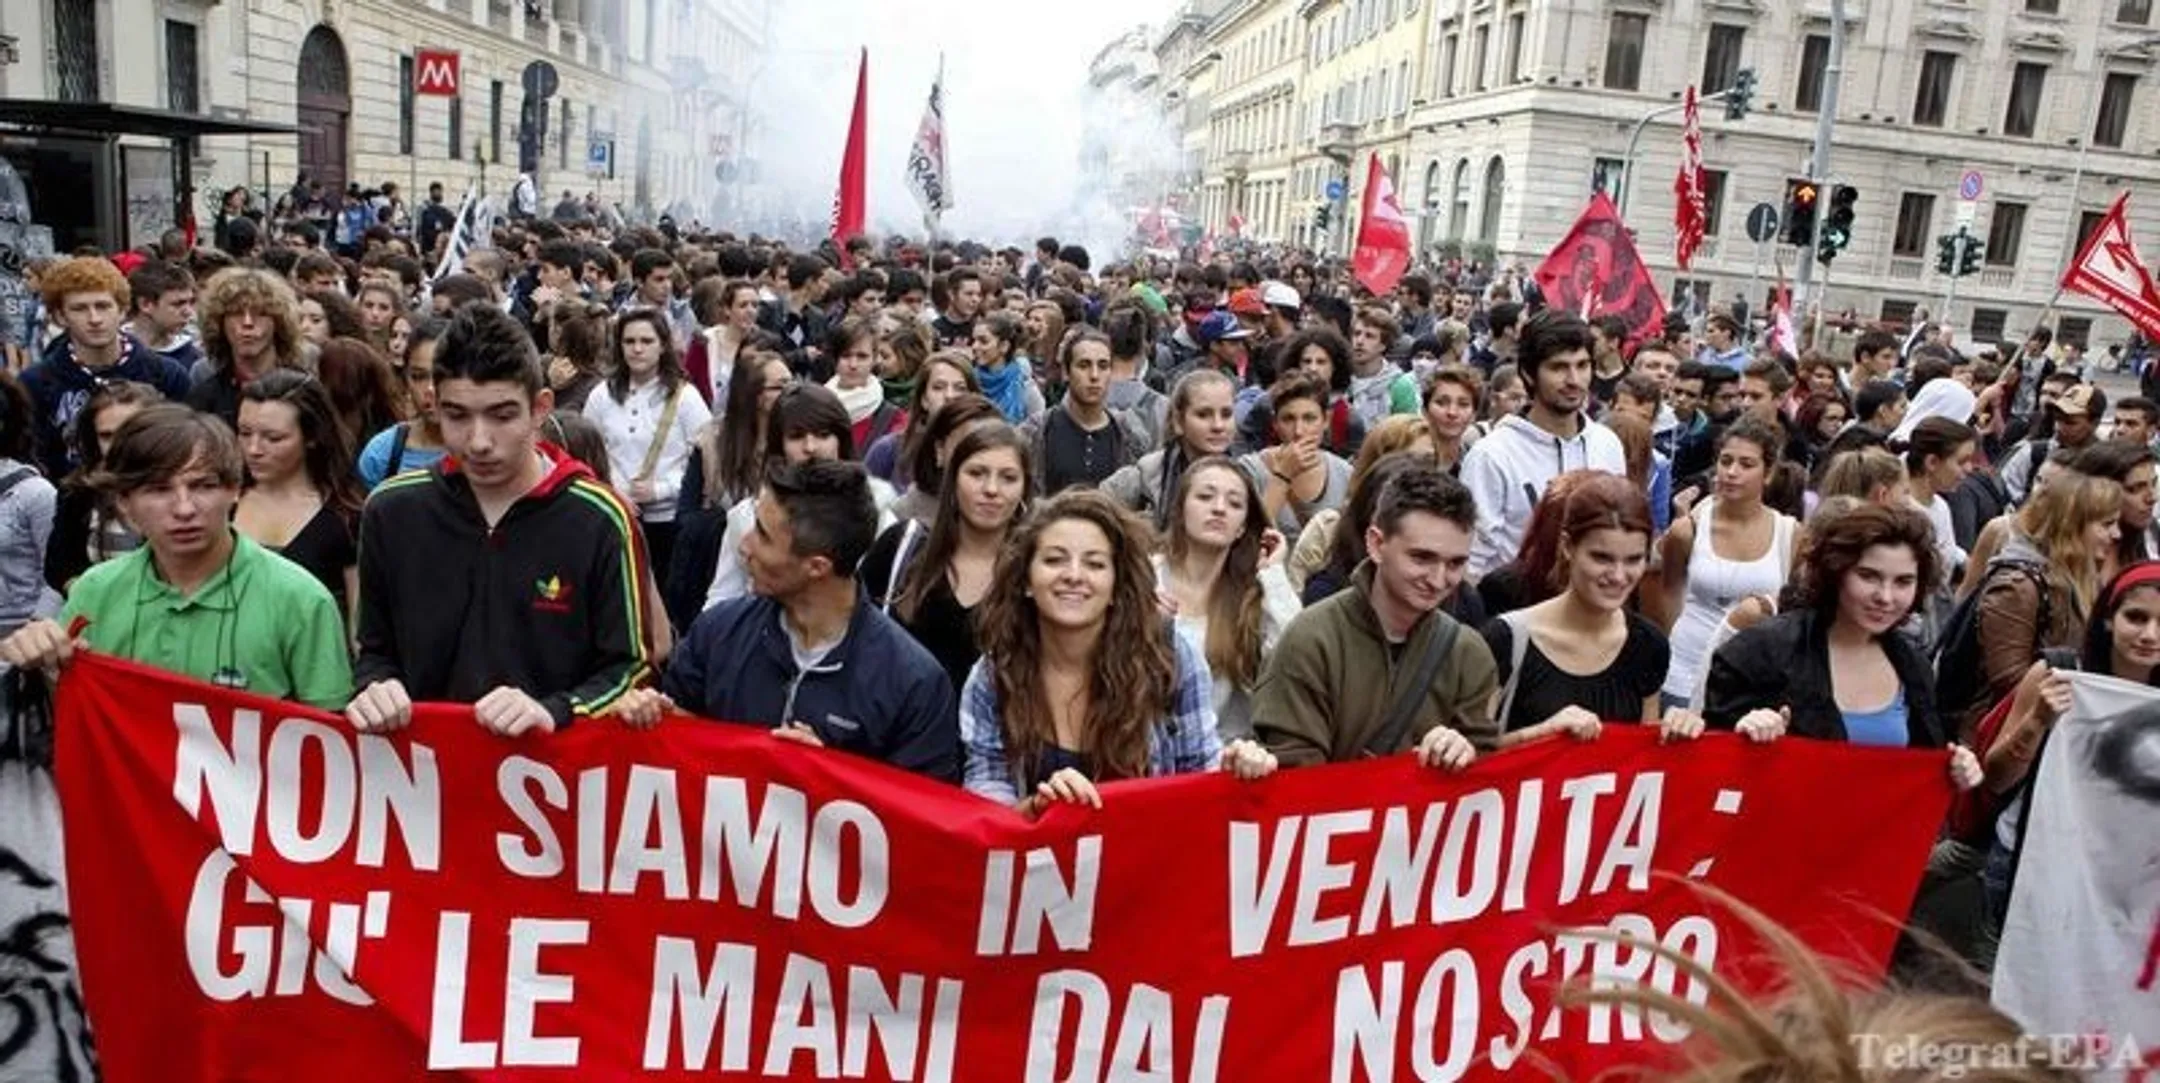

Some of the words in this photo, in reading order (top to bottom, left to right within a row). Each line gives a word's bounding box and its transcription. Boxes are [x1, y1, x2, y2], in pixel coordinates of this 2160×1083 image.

[420, 59, 455, 88] M
[173, 703, 441, 871] NON
[496, 765, 890, 928] SIAMO
[977, 835, 1103, 955] IN
[427, 912, 590, 1071] LE
[643, 935, 963, 1083] MANI
[1331, 914, 1718, 1083] NOSTRO
